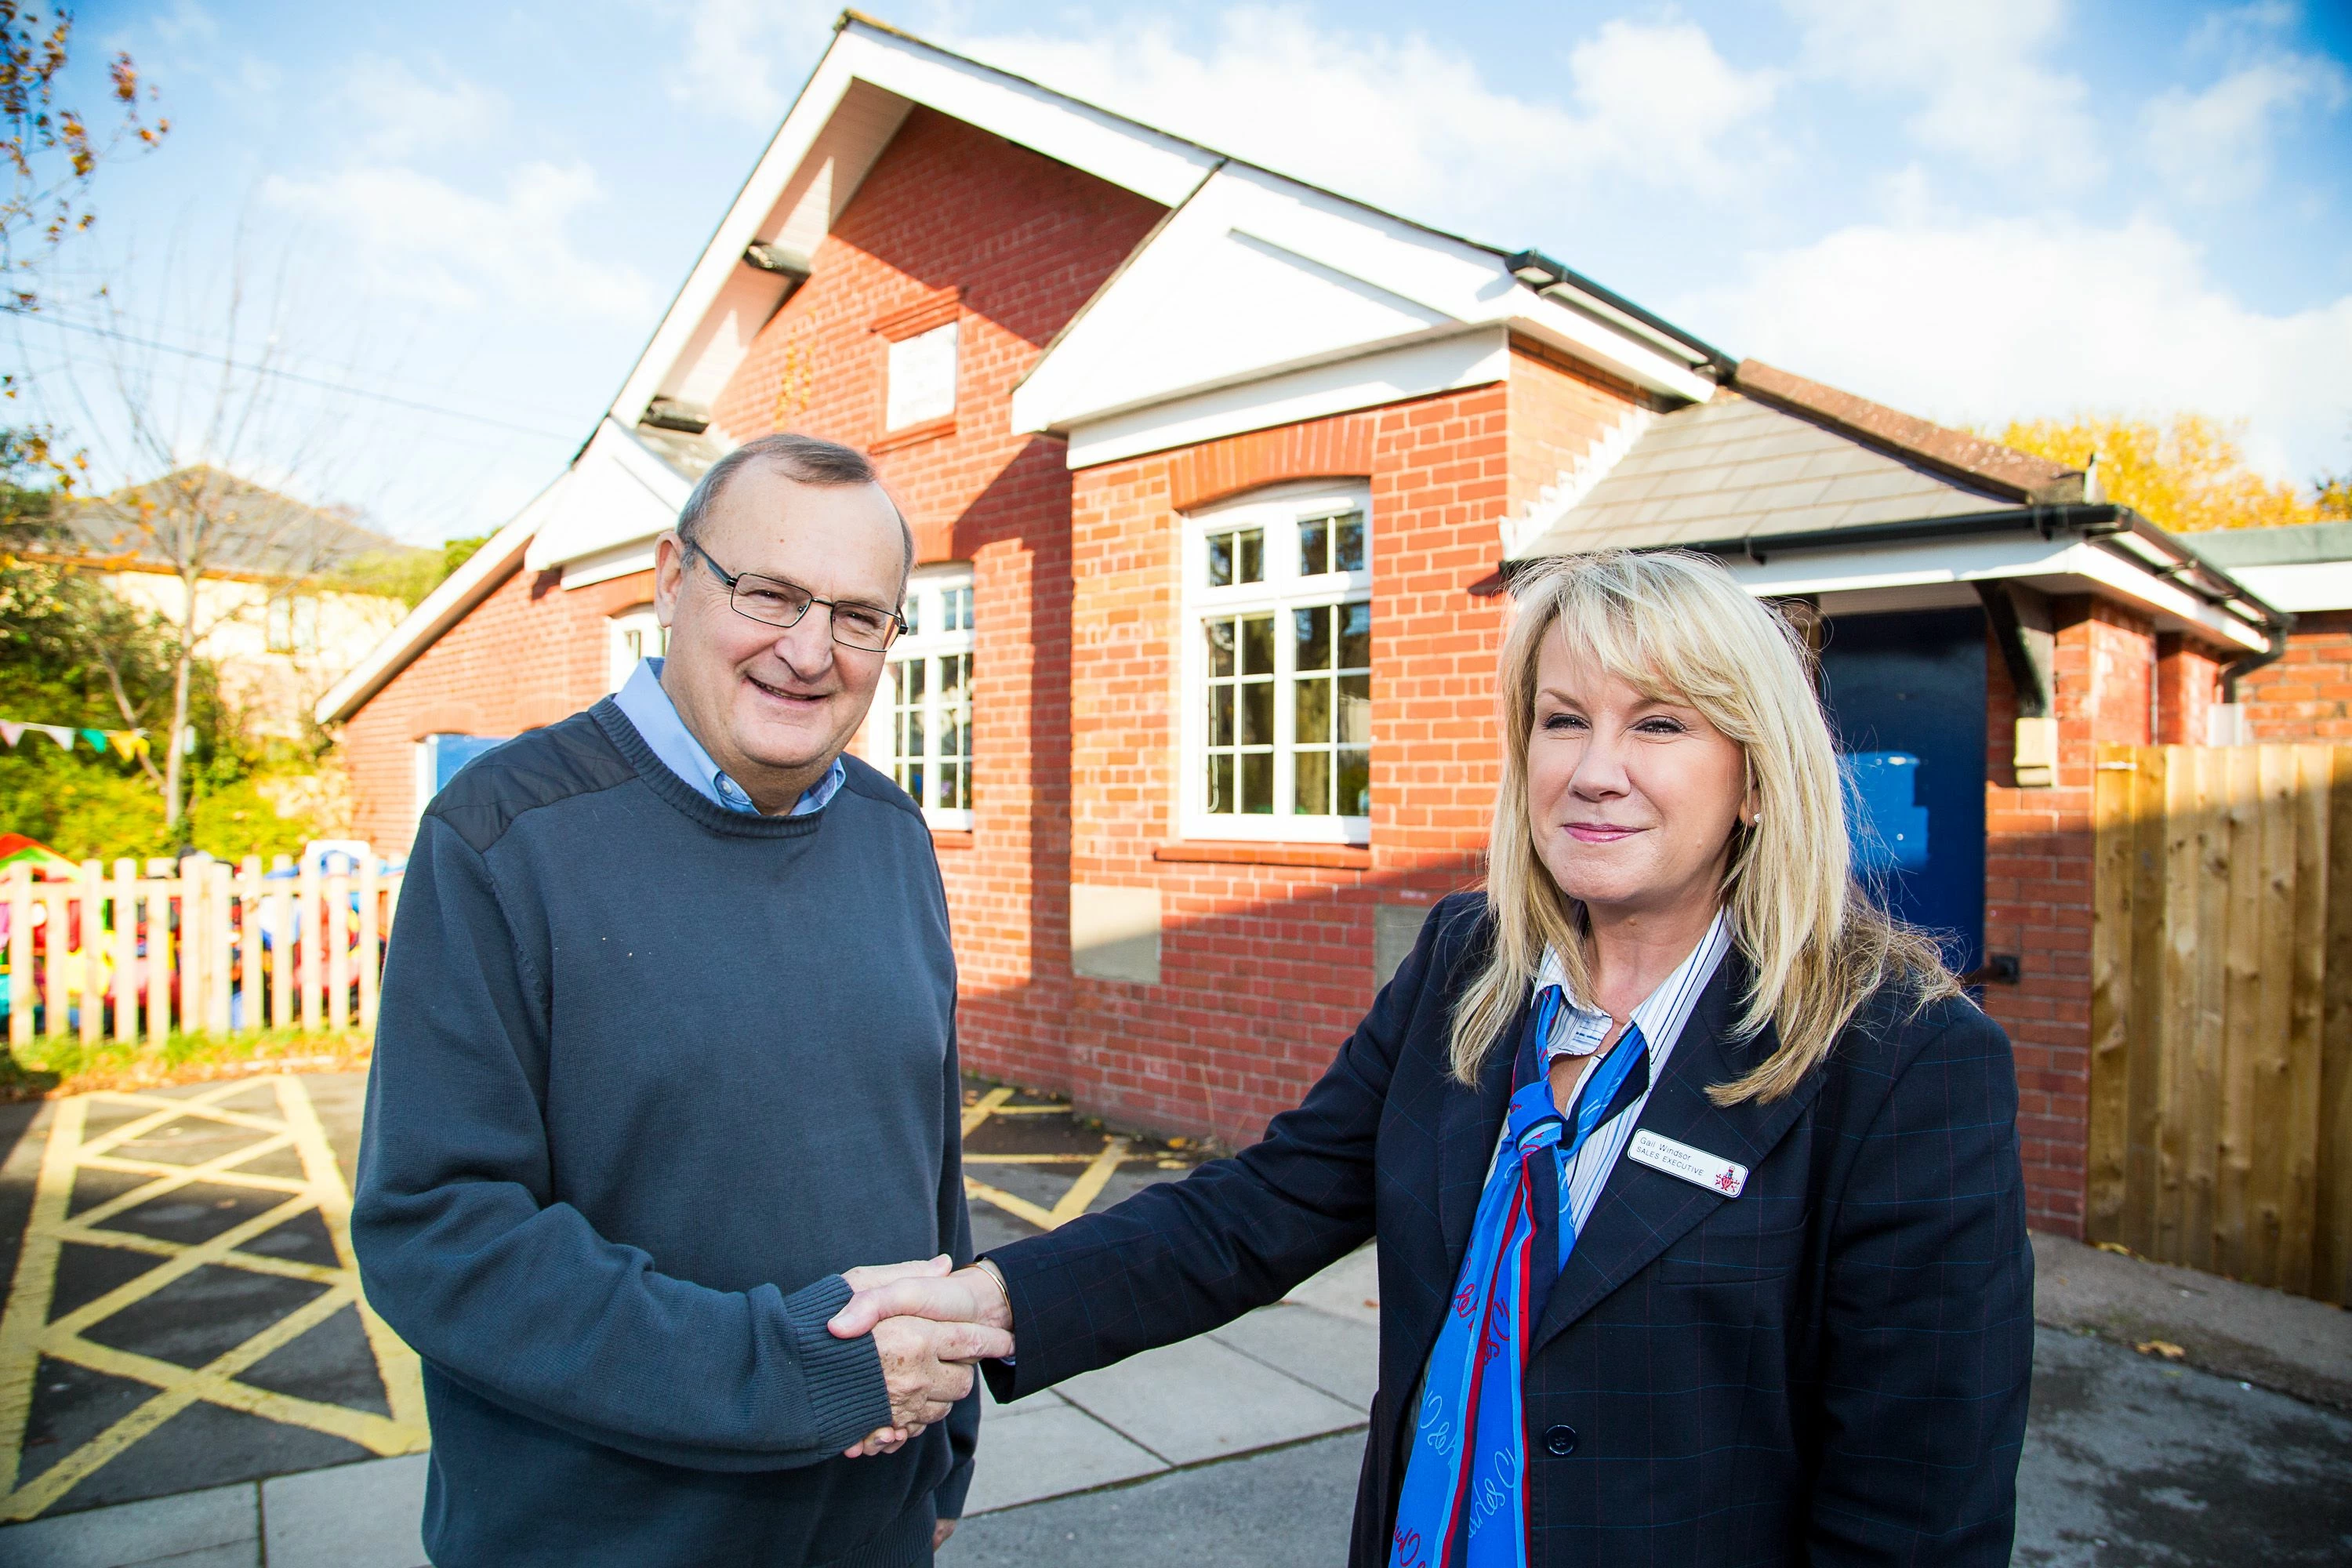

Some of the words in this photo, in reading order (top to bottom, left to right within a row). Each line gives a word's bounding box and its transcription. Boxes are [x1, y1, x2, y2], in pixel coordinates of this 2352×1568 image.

[1636, 1147, 1659, 1159] SALES
[1662, 1156, 1704, 1175] EXECUTIVE
[1640, 1137, 1656, 1148] Gail
[1660, 1144, 1692, 1160] Windsor
